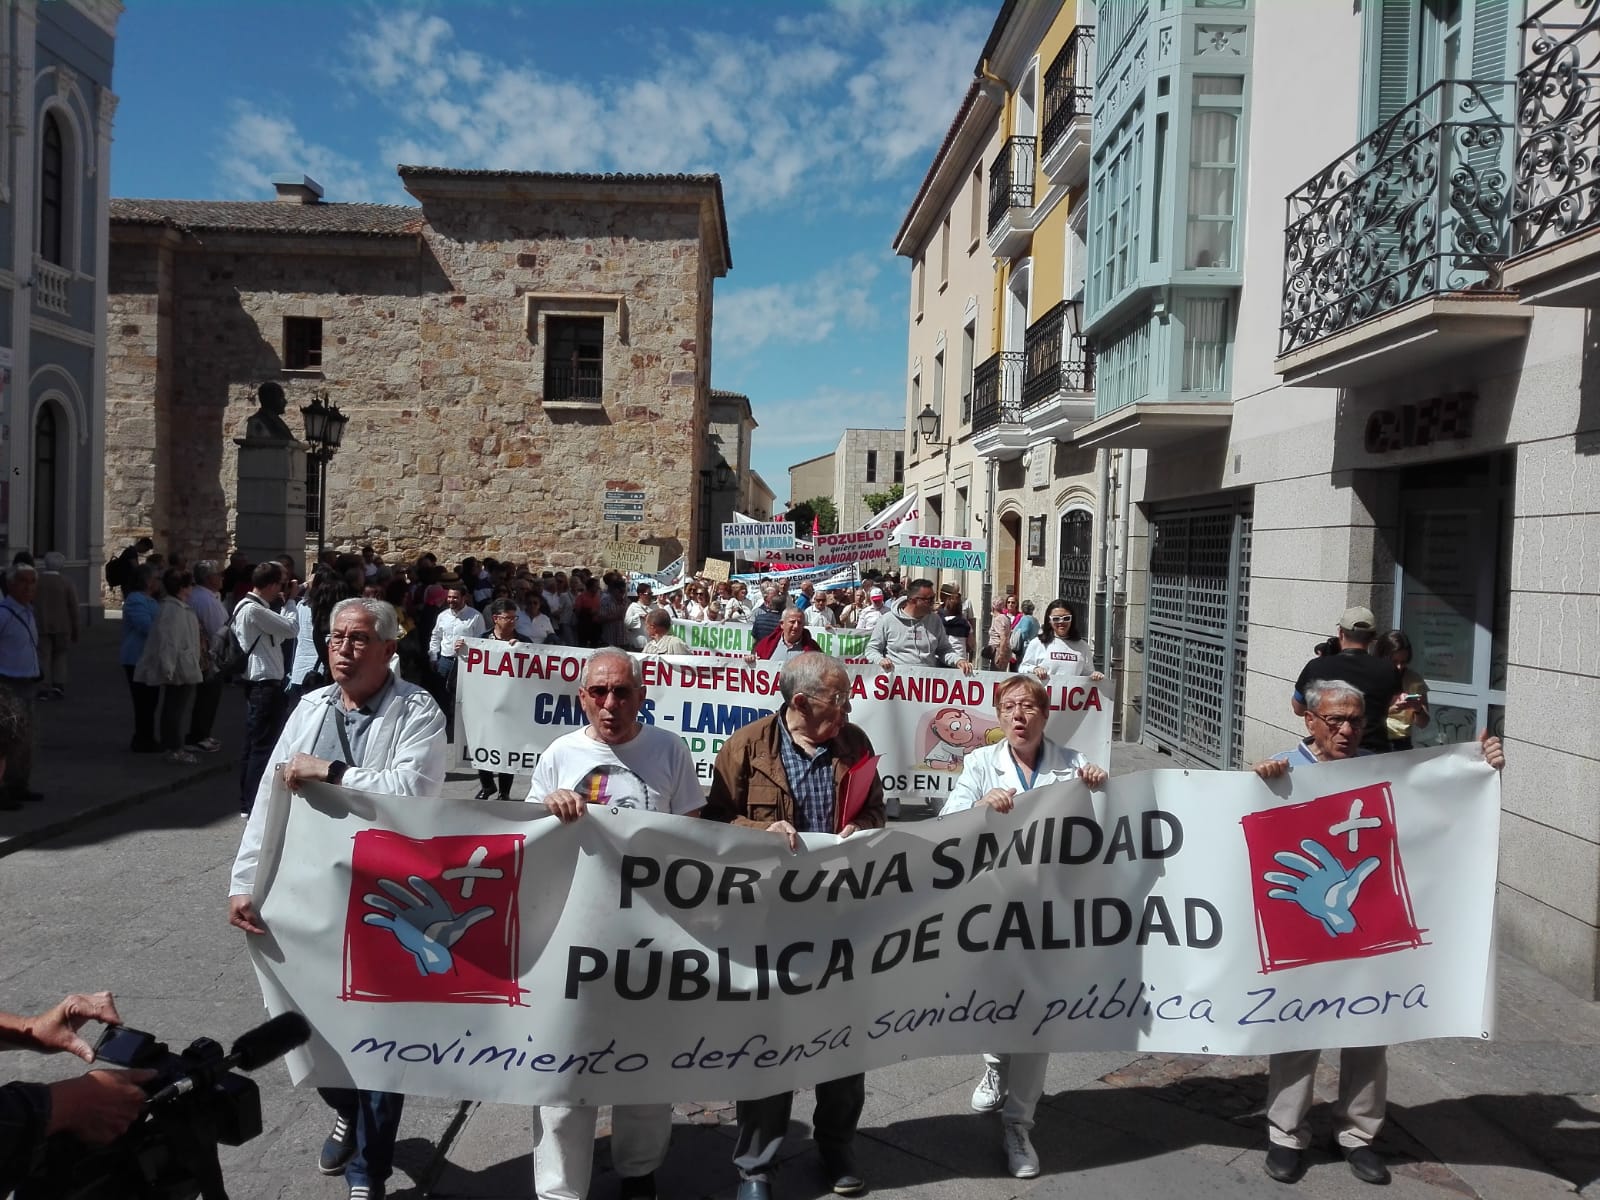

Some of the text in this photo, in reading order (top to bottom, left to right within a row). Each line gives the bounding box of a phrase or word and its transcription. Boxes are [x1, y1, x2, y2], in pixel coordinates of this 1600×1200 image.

[724, 523, 793, 536] FARAMONTANOS
[817, 530, 885, 548] POZUELO
[909, 535, 972, 551] Tábara
[766, 551, 815, 562] 24 HOR
[818, 551, 858, 565] SANIDAD
[911, 556, 921, 566] LA
[924, 556, 965, 568] SANIDAD
[964, 553, 982, 569] YA
[691, 623, 742, 650] BÁSICA
[817, 631, 872, 656] DE TÁB
[466, 648, 587, 684] PLATAFO
[641, 661, 673, 688] EN
[874, 674, 985, 706] SANIDAD
[682, 701, 774, 736] LAMP
[463, 745, 541, 769] LOS PE
[914, 774, 940, 791] EN
[619, 809, 1185, 910] POR UNA SANIDAD
[562, 894, 1225, 1003] PÚBLICA DE CALIDAD
[350, 977, 1430, 1076] movimiento defensa sanidad pública Zamora
